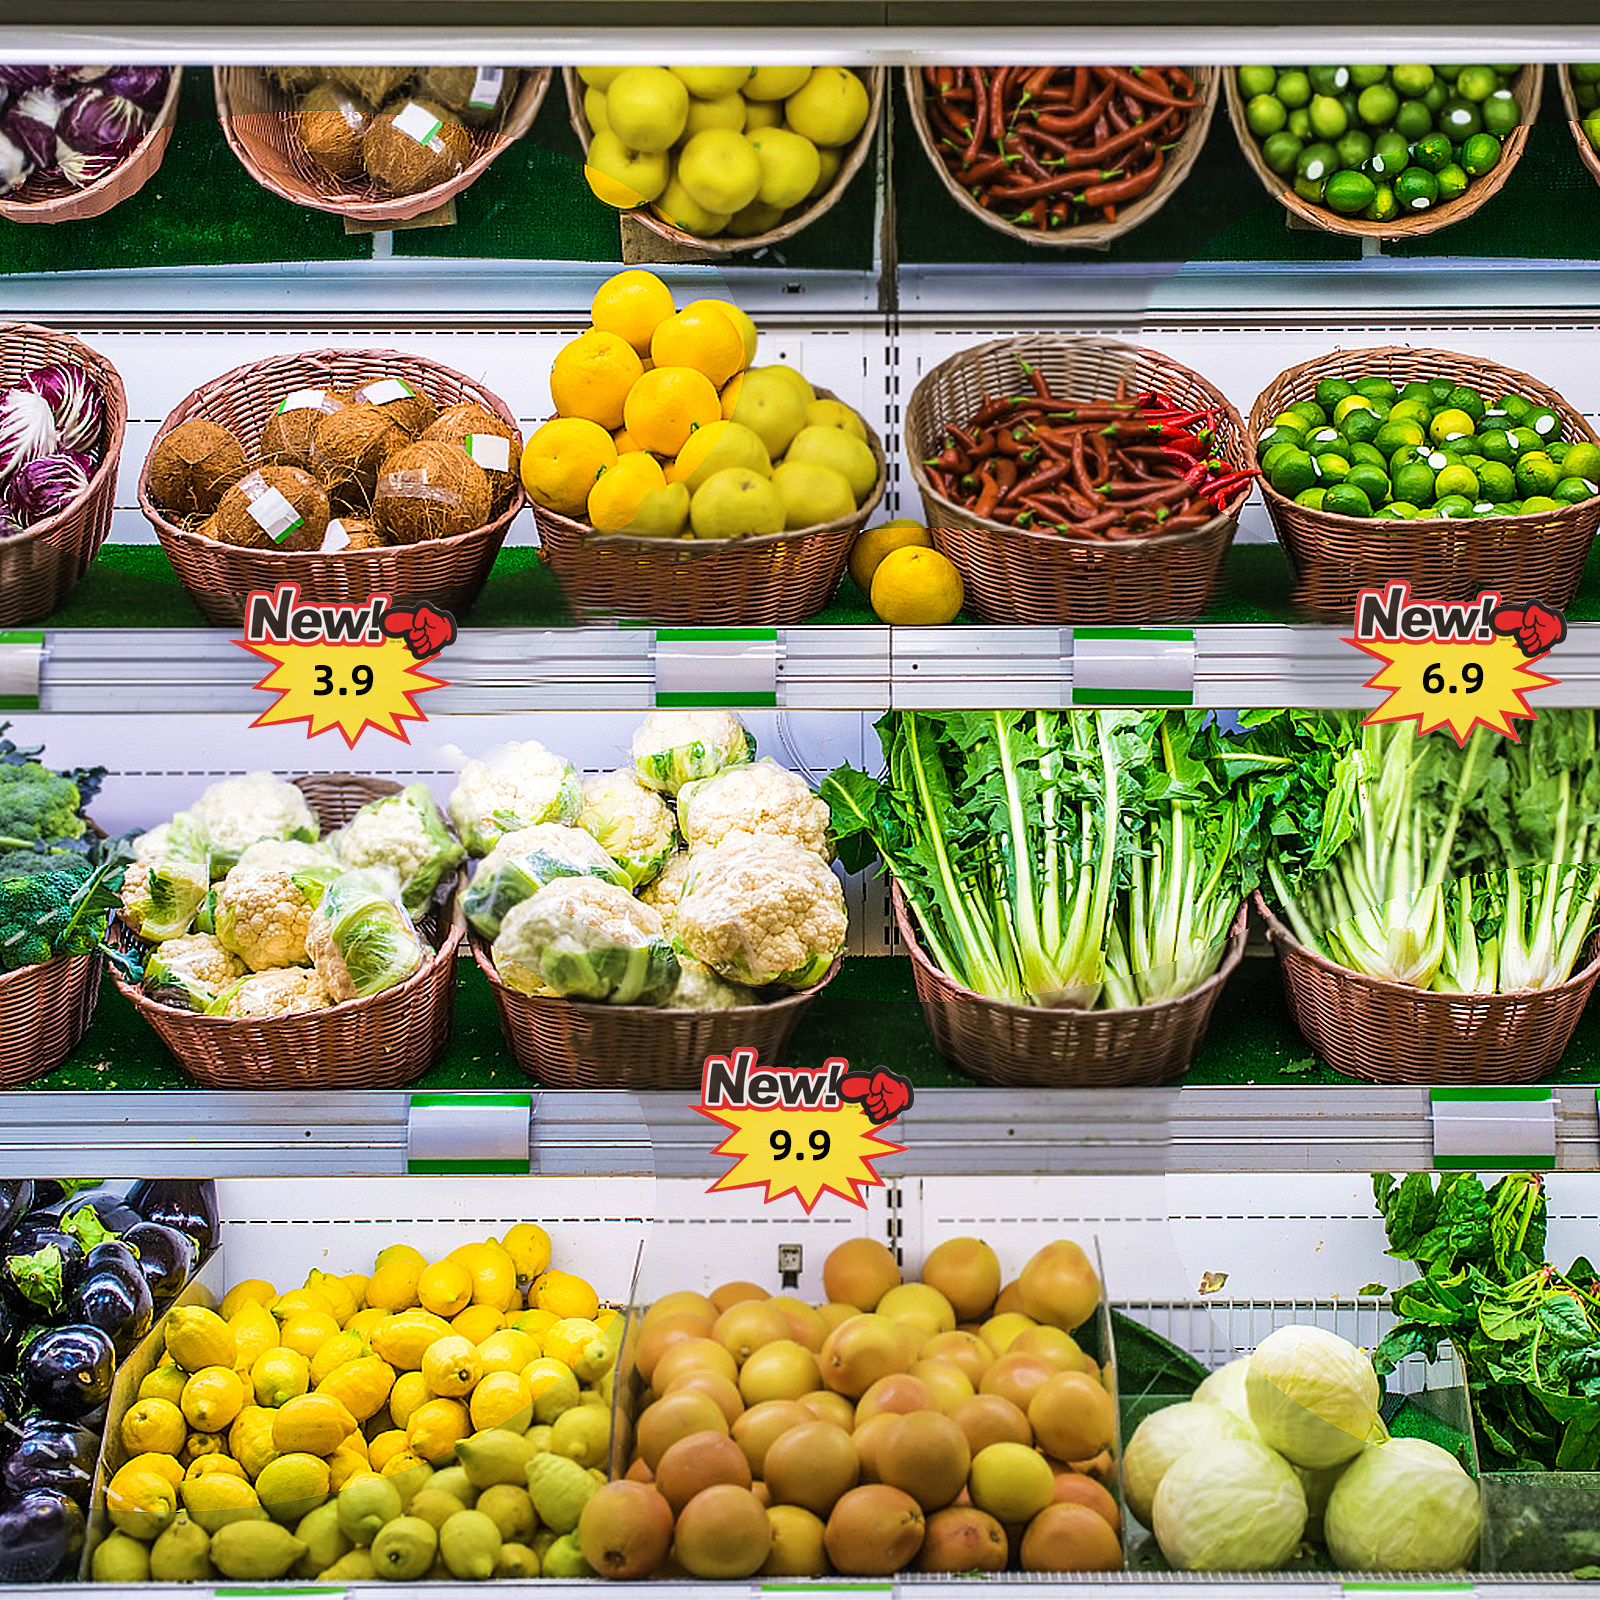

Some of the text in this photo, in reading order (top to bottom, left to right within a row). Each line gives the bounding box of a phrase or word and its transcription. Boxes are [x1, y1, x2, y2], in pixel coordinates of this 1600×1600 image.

[249, 588, 387, 641] New!
[1359, 586, 1497, 639] New!
[313, 664, 374, 696] 3.9
[1422, 662, 1484, 694] 6.9
[706, 1053, 844, 1106] New!
[769, 1129, 831, 1161] 9.9
